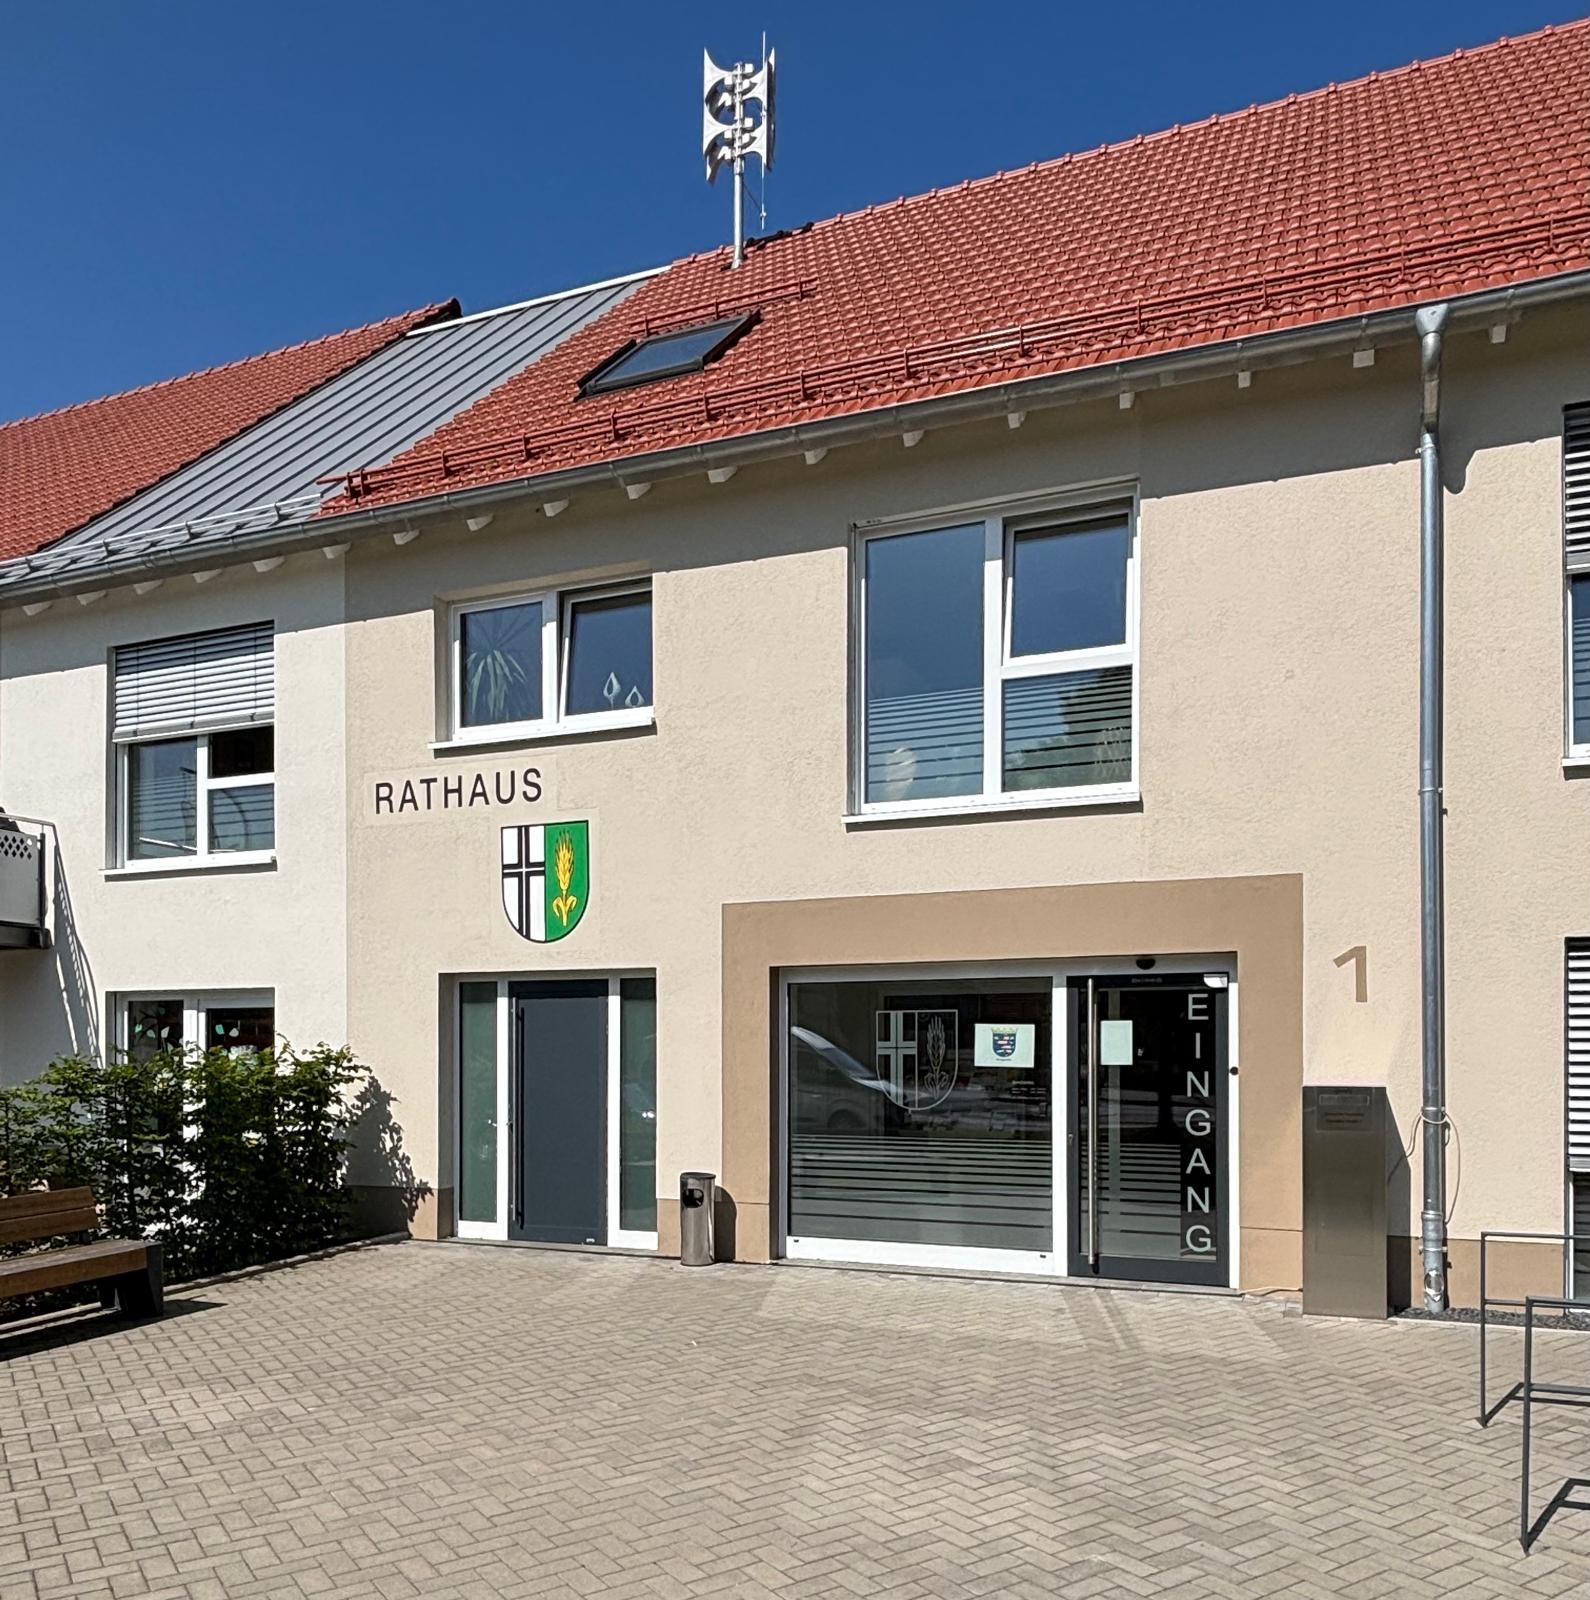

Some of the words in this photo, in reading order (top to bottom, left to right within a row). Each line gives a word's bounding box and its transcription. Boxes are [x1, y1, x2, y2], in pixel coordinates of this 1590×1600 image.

[375, 768, 543, 815] RATHAUS
[1333, 945, 1368, 1003] 1
[1184, 993, 1213, 1254] EINGANG
